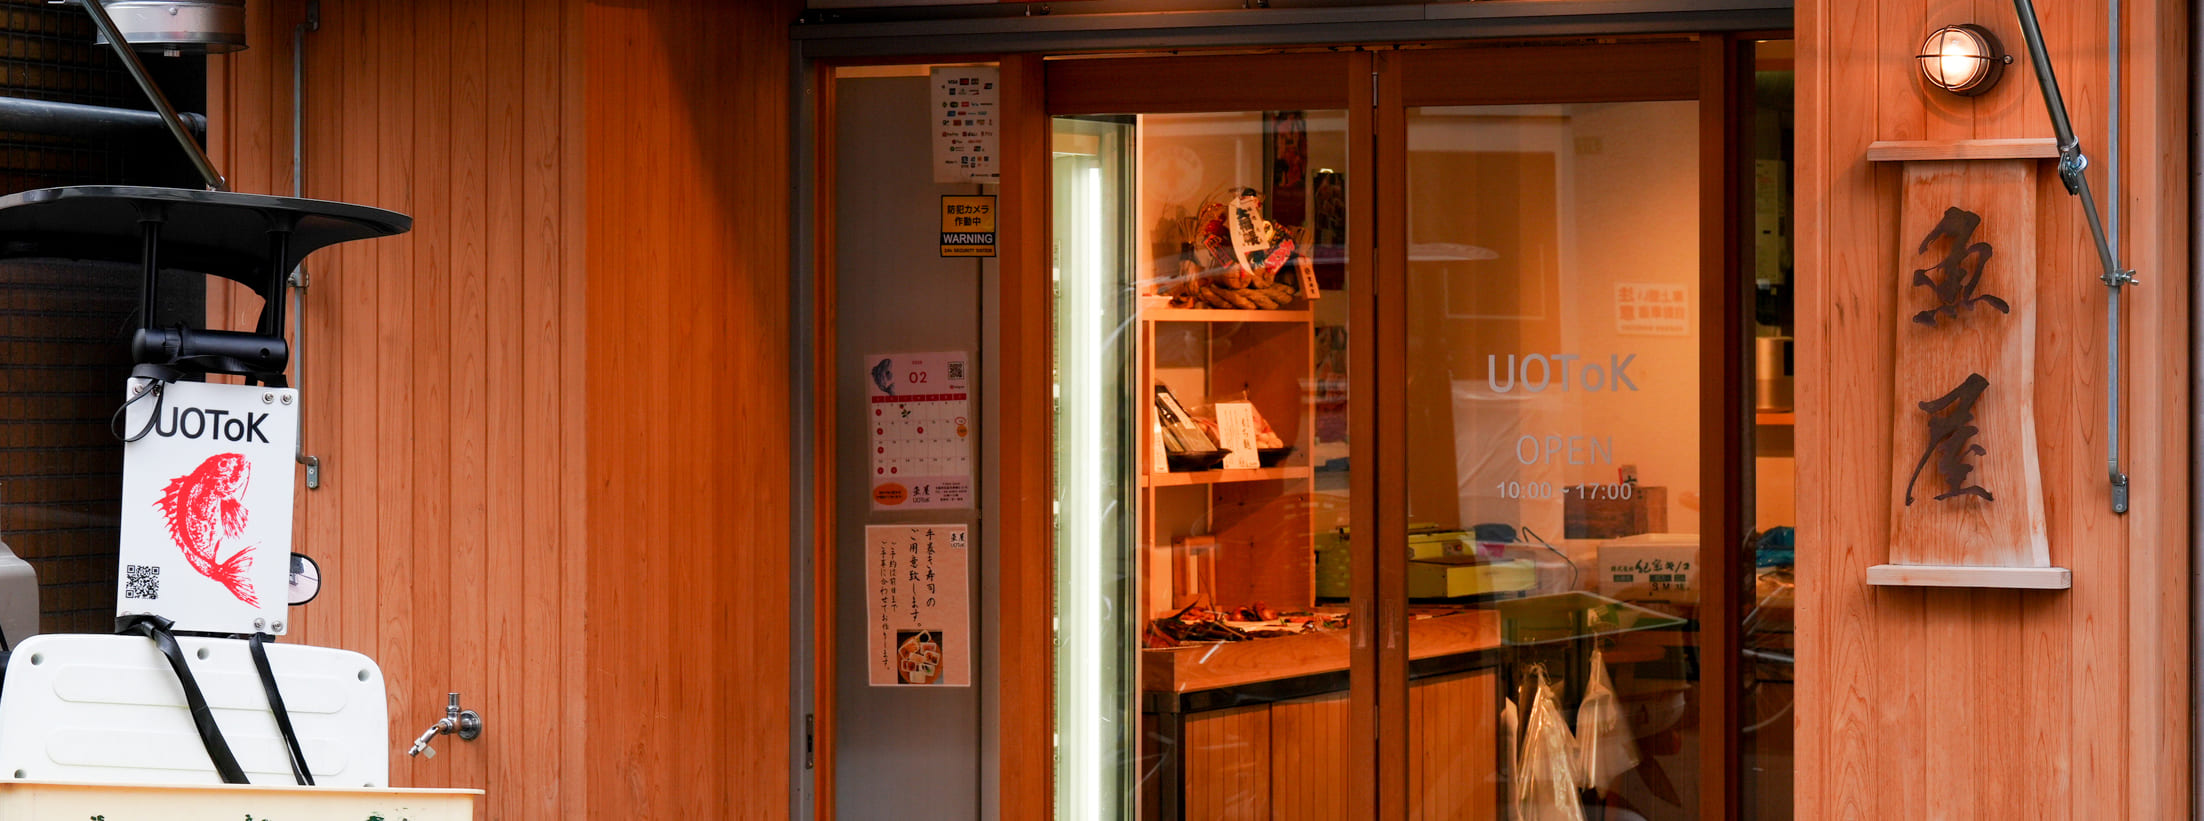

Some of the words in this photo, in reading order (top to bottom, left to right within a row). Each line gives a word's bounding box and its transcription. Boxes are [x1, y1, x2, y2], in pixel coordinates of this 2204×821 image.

[947, 205, 989, 215] 防犯カメラ
[955, 216, 981, 227] 作動中
[943, 233, 993, 244] WARNING
[1905, 206, 2010, 506] 魚屋
[909, 371, 928, 384] 02
[1488, 353, 1640, 393] UOToK
[155, 407, 269, 443] UOToK
[1516, 434, 1613, 466] OPEN
[1496, 481, 1552, 500] 10:00
[1576, 481, 1632, 500] 17:00
[908, 528, 922, 627] ご用意致します。
[926, 528, 936, 608] 手巻き寿司の
